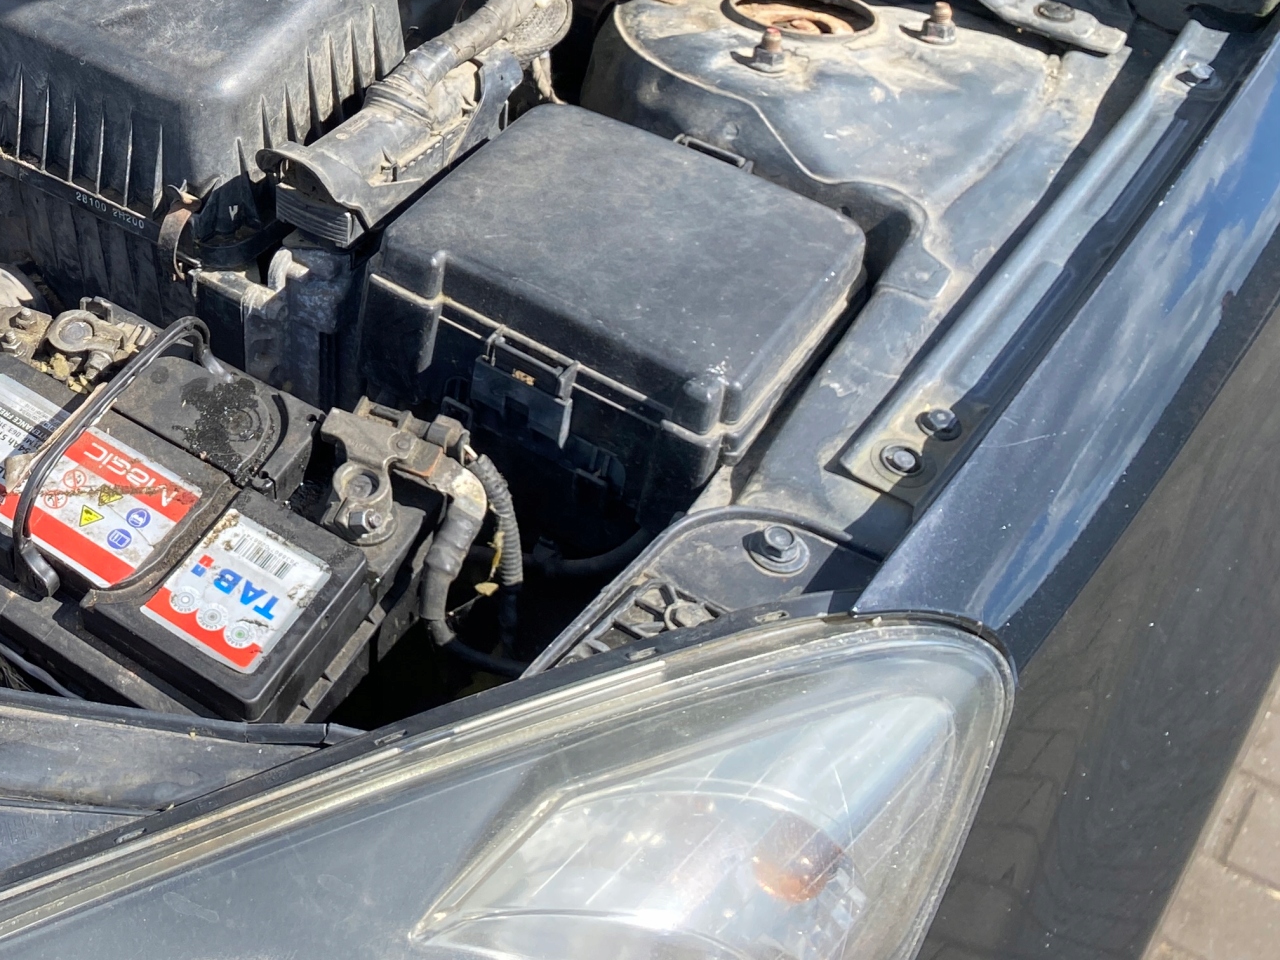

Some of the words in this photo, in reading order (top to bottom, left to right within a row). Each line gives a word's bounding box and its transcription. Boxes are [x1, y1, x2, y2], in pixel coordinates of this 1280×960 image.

[75, 191, 107, 212] 28100
[7, 438, 32, 455] 54Ah
[213, 568, 279, 620] TAB
